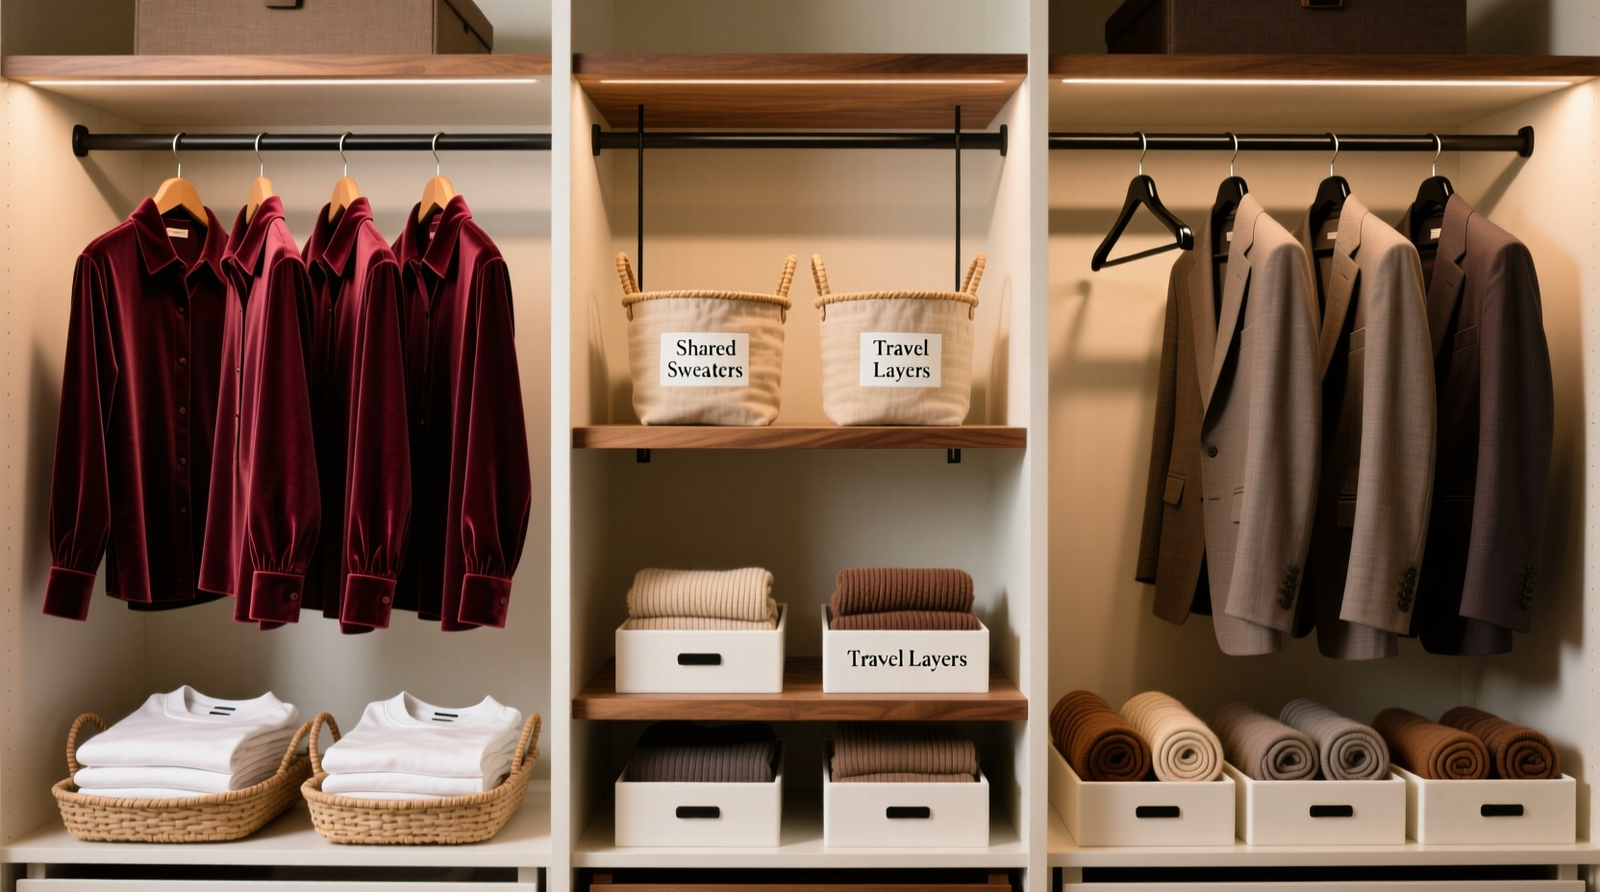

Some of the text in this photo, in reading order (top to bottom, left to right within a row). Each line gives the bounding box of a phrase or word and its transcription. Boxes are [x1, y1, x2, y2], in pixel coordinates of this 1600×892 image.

[676, 338, 737, 357] Shared
[872, 338, 930, 357] Travel
[667, 360, 743, 378] Sweaters
[873, 361, 931, 383] Layers
[846, 648, 968, 672] Travel Layers
